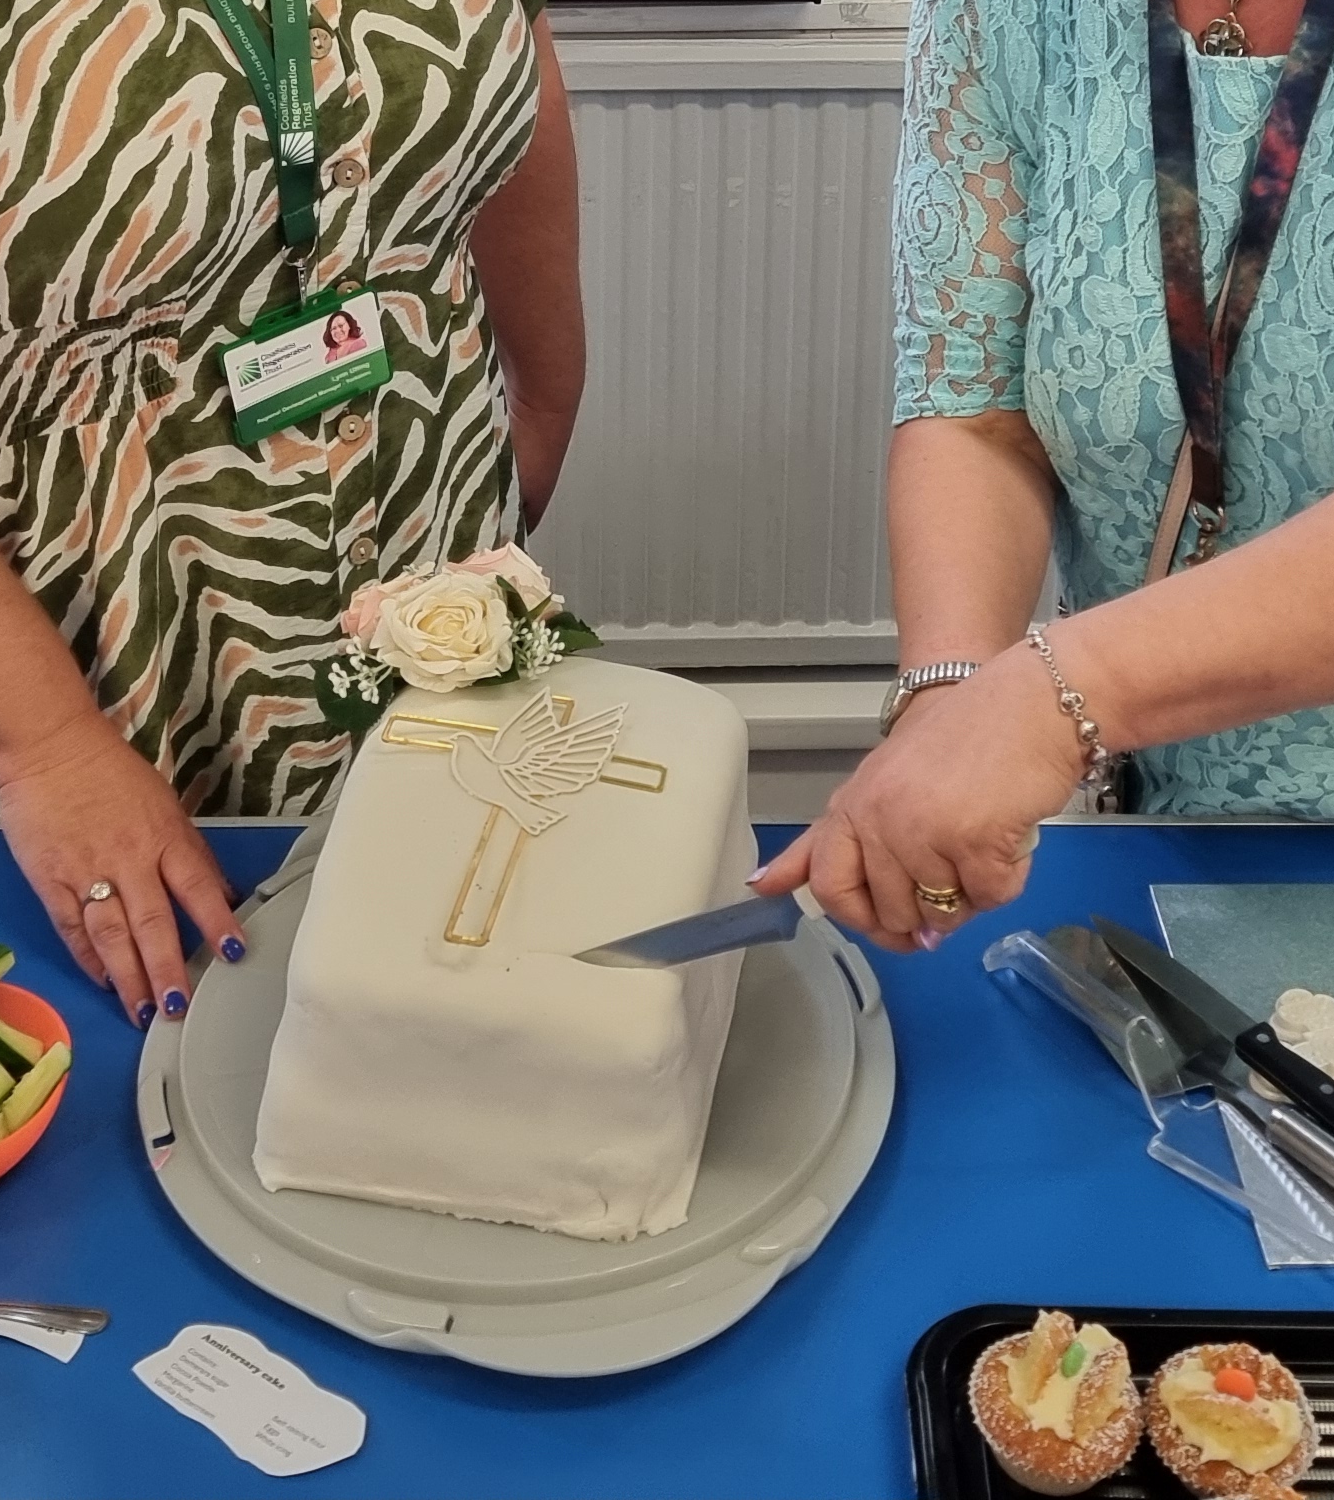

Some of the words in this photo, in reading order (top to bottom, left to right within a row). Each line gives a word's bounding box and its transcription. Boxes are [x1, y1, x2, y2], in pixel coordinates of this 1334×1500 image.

[234, 23, 269, 82] PROSPERITY
[280, 79, 290, 131] Coalfields
[288, 58, 302, 130] Regeneration
[302, 102, 312, 128] Trust
[200, 1333, 261, 1375] Anniversary
[260, 1371, 286, 1390] cake
